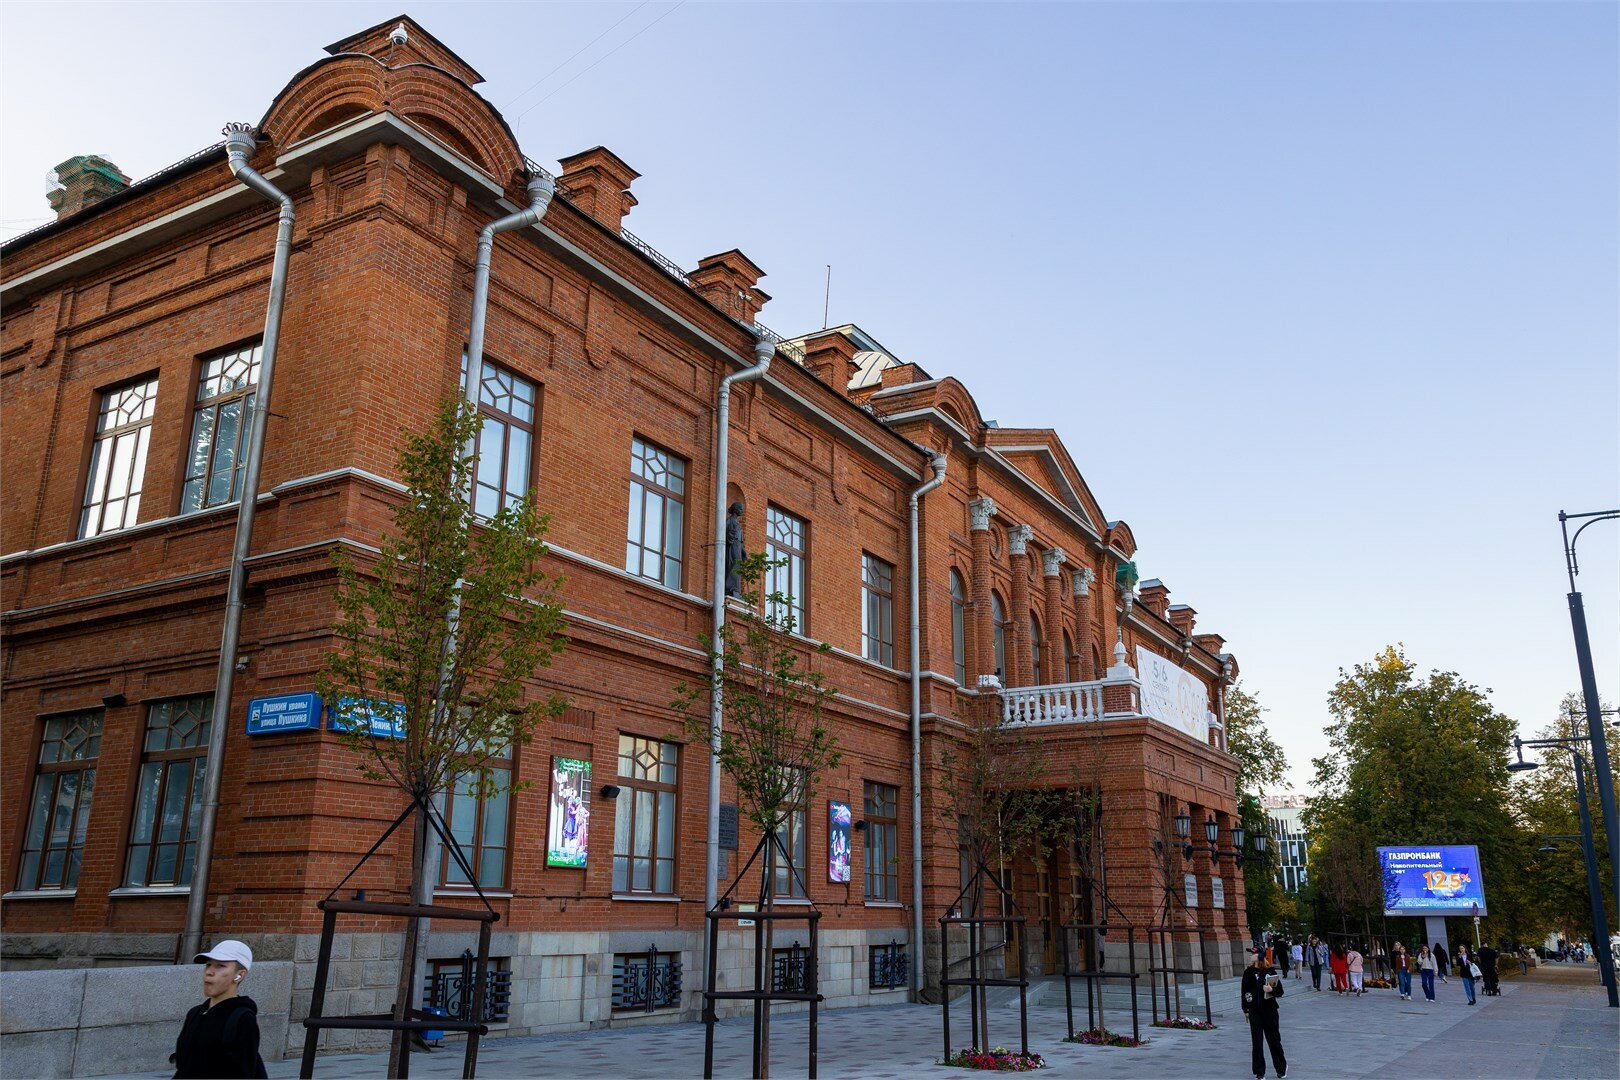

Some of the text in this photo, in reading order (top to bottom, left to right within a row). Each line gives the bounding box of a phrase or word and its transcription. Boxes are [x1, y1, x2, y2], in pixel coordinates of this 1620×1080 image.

[262, 702, 287, 713] Пушкин
[260, 714, 307, 728] улица Пушкина
[1388, 852, 1440, 860] ГАЗПРОМБАНК
